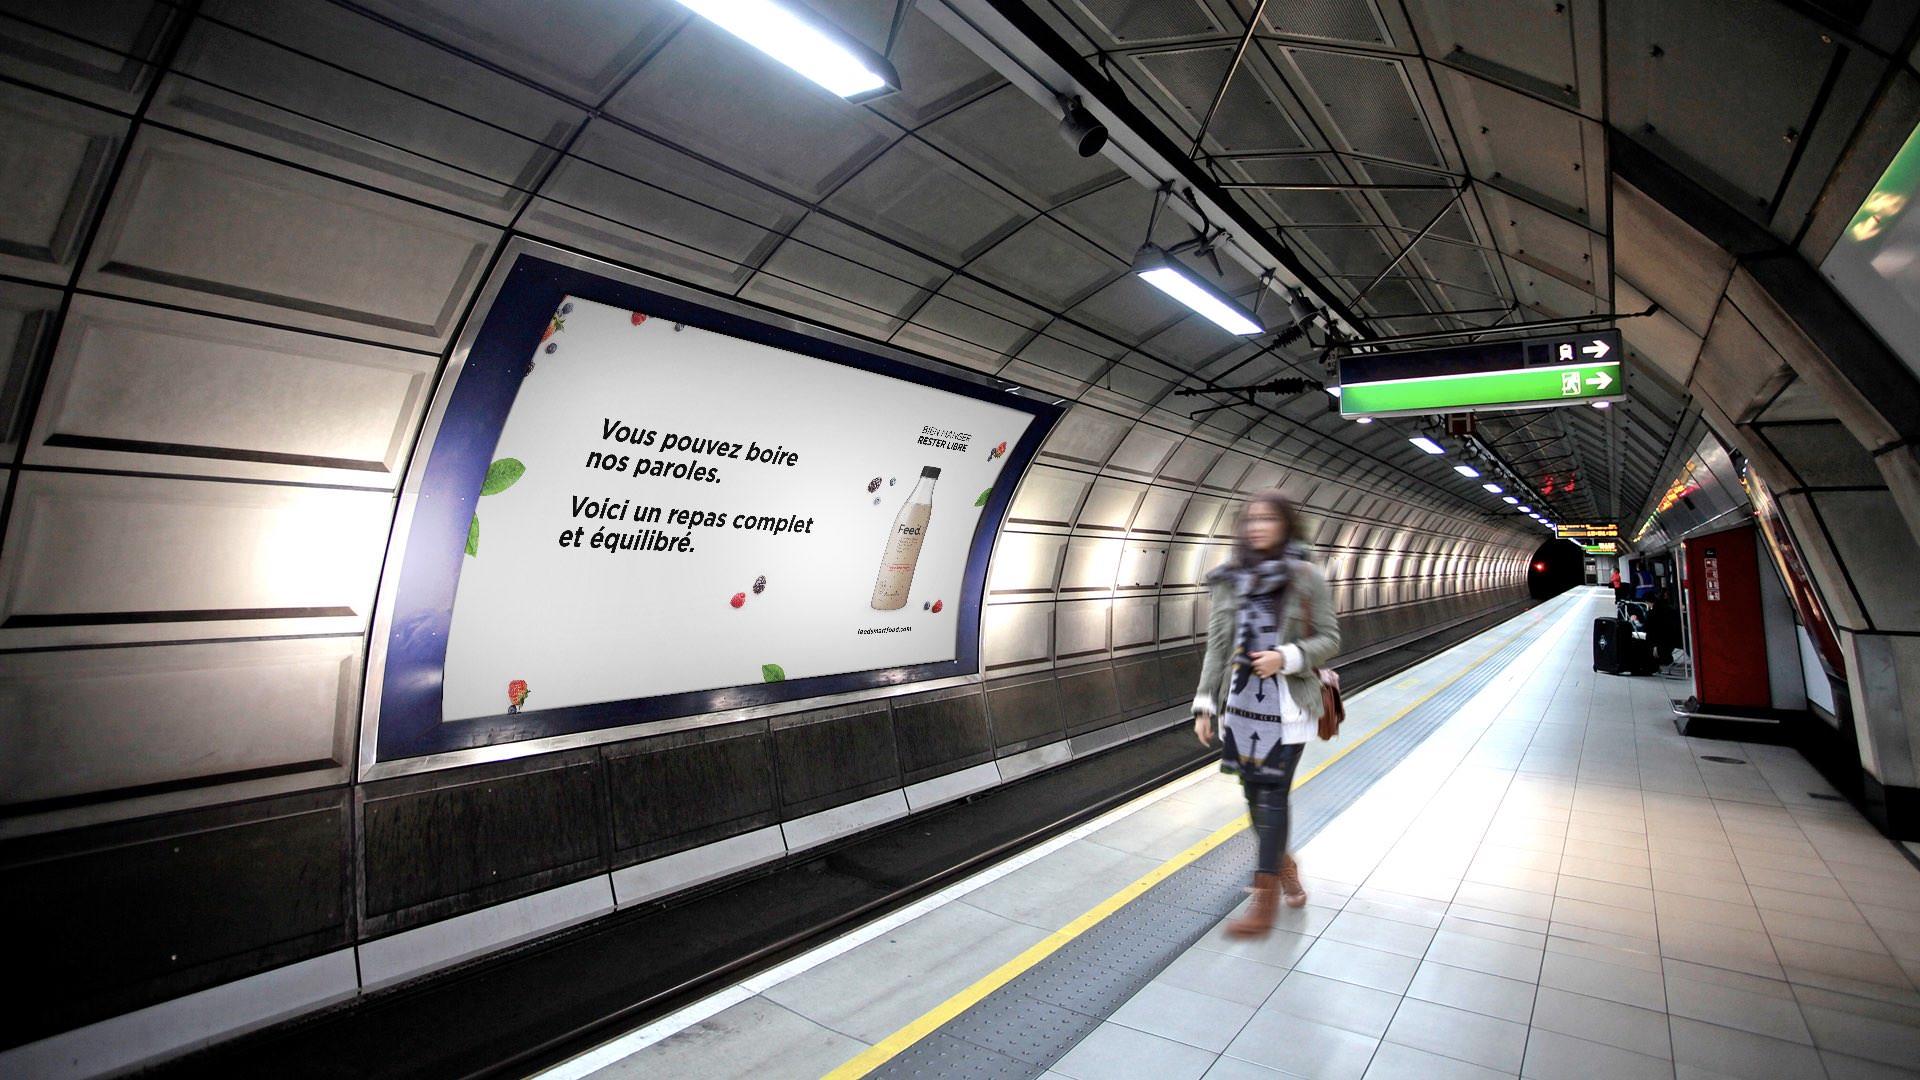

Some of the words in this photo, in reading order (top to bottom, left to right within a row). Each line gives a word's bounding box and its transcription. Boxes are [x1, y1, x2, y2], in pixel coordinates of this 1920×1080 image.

[602, 418, 658, 447] Vous
[659, 433, 743, 460] pouvez
[745, 441, 799, 467] boire
[917, 435, 947, 449] RESTER
[946, 441, 969, 453] LIBRE
[921, 425, 940, 436] BIEN
[585, 451, 630, 472] nos
[633, 459, 721, 484] paroles.
[571, 495, 630, 521] Voici
[633, 505, 662, 523] un
[667, 508, 728, 530] repas
[732, 514, 814, 535] complet
[558, 525, 585, 548] et
[590, 525, 695, 553] équilibré.
